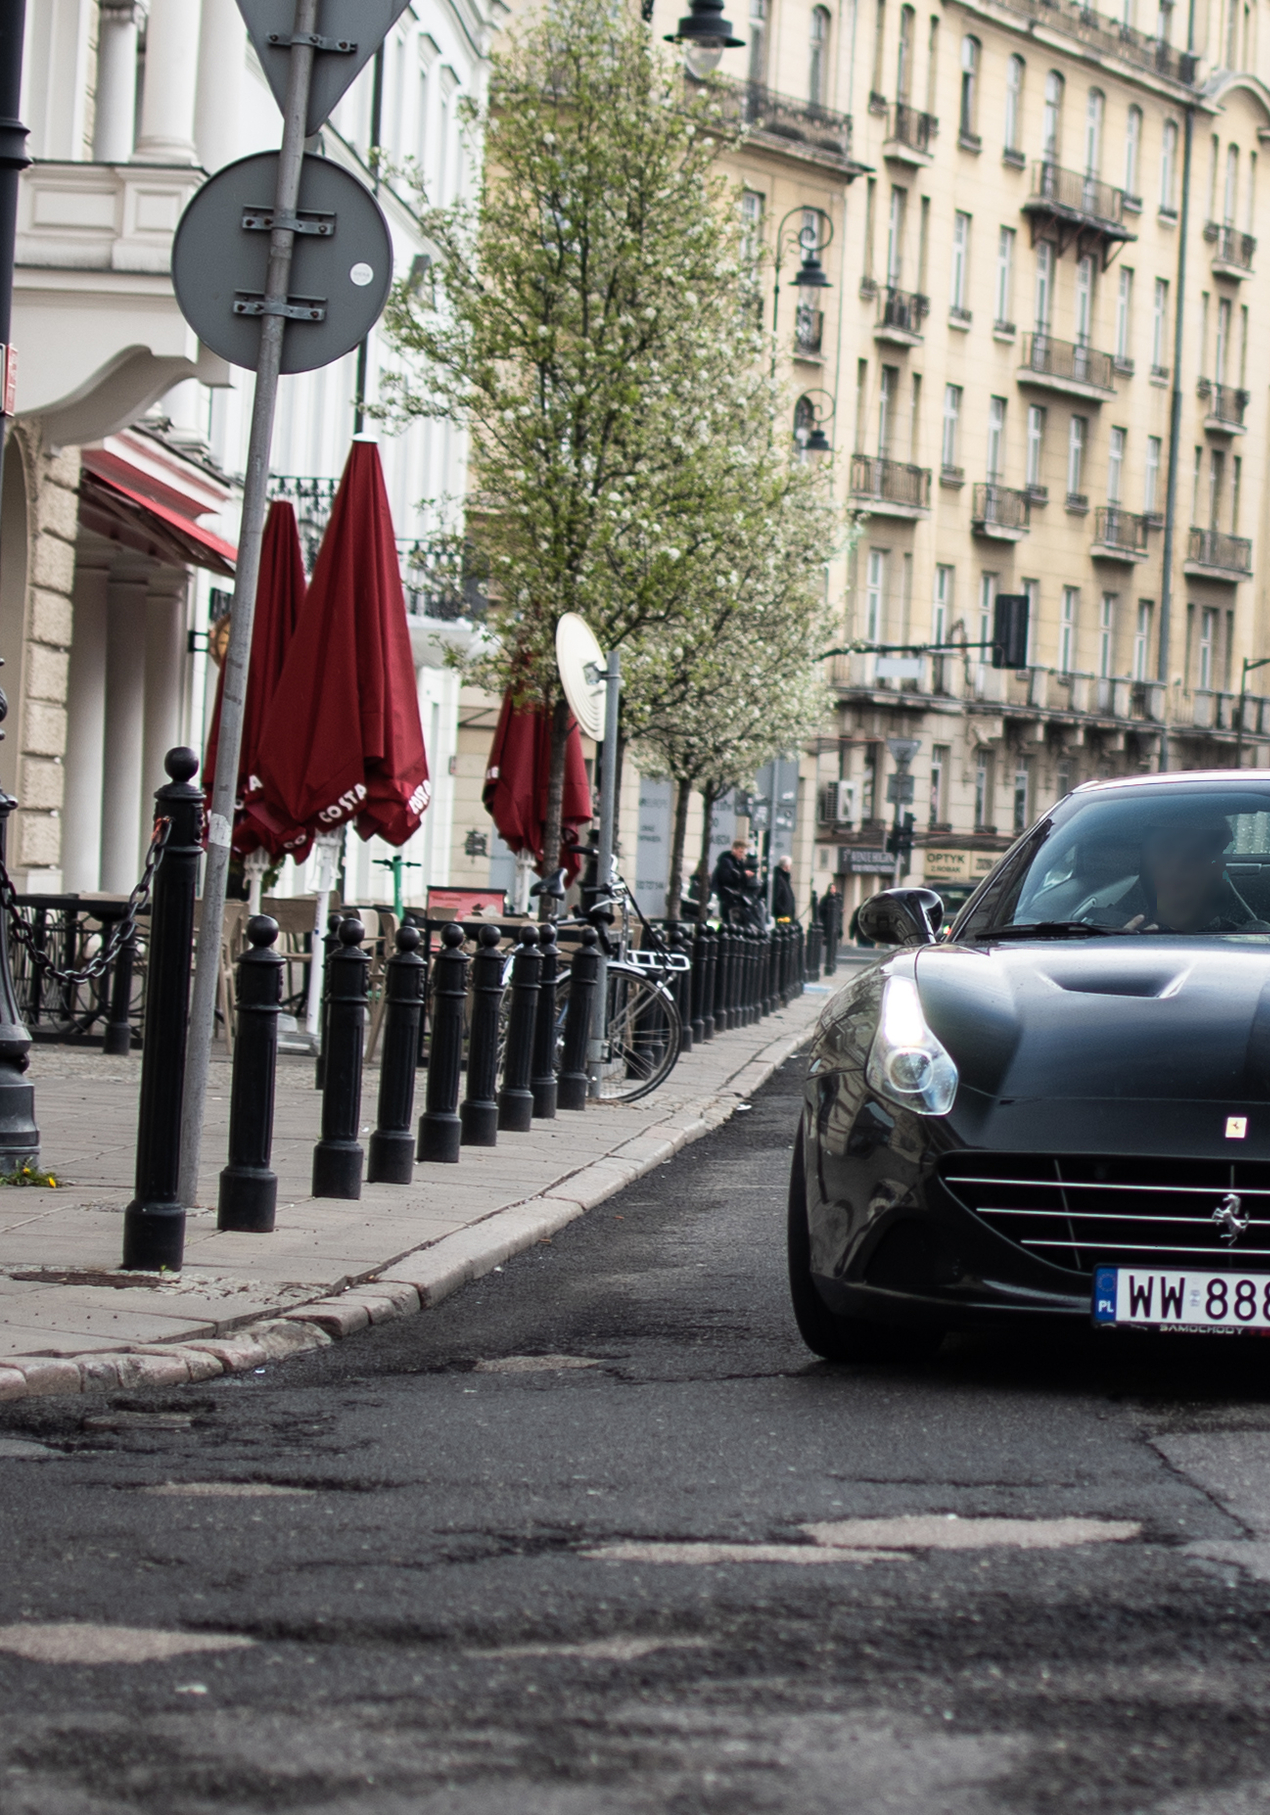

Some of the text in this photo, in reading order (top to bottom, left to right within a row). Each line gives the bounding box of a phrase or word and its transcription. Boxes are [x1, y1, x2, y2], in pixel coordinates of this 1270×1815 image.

[318, 783, 367, 823] COSTA
[927, 853, 965, 863] OPTYK
[1098, 1300, 1114, 1313] PL
[1129, 1275, 1185, 1319] WW
[1159, 1324, 1244, 1335] SAMOCHODY
